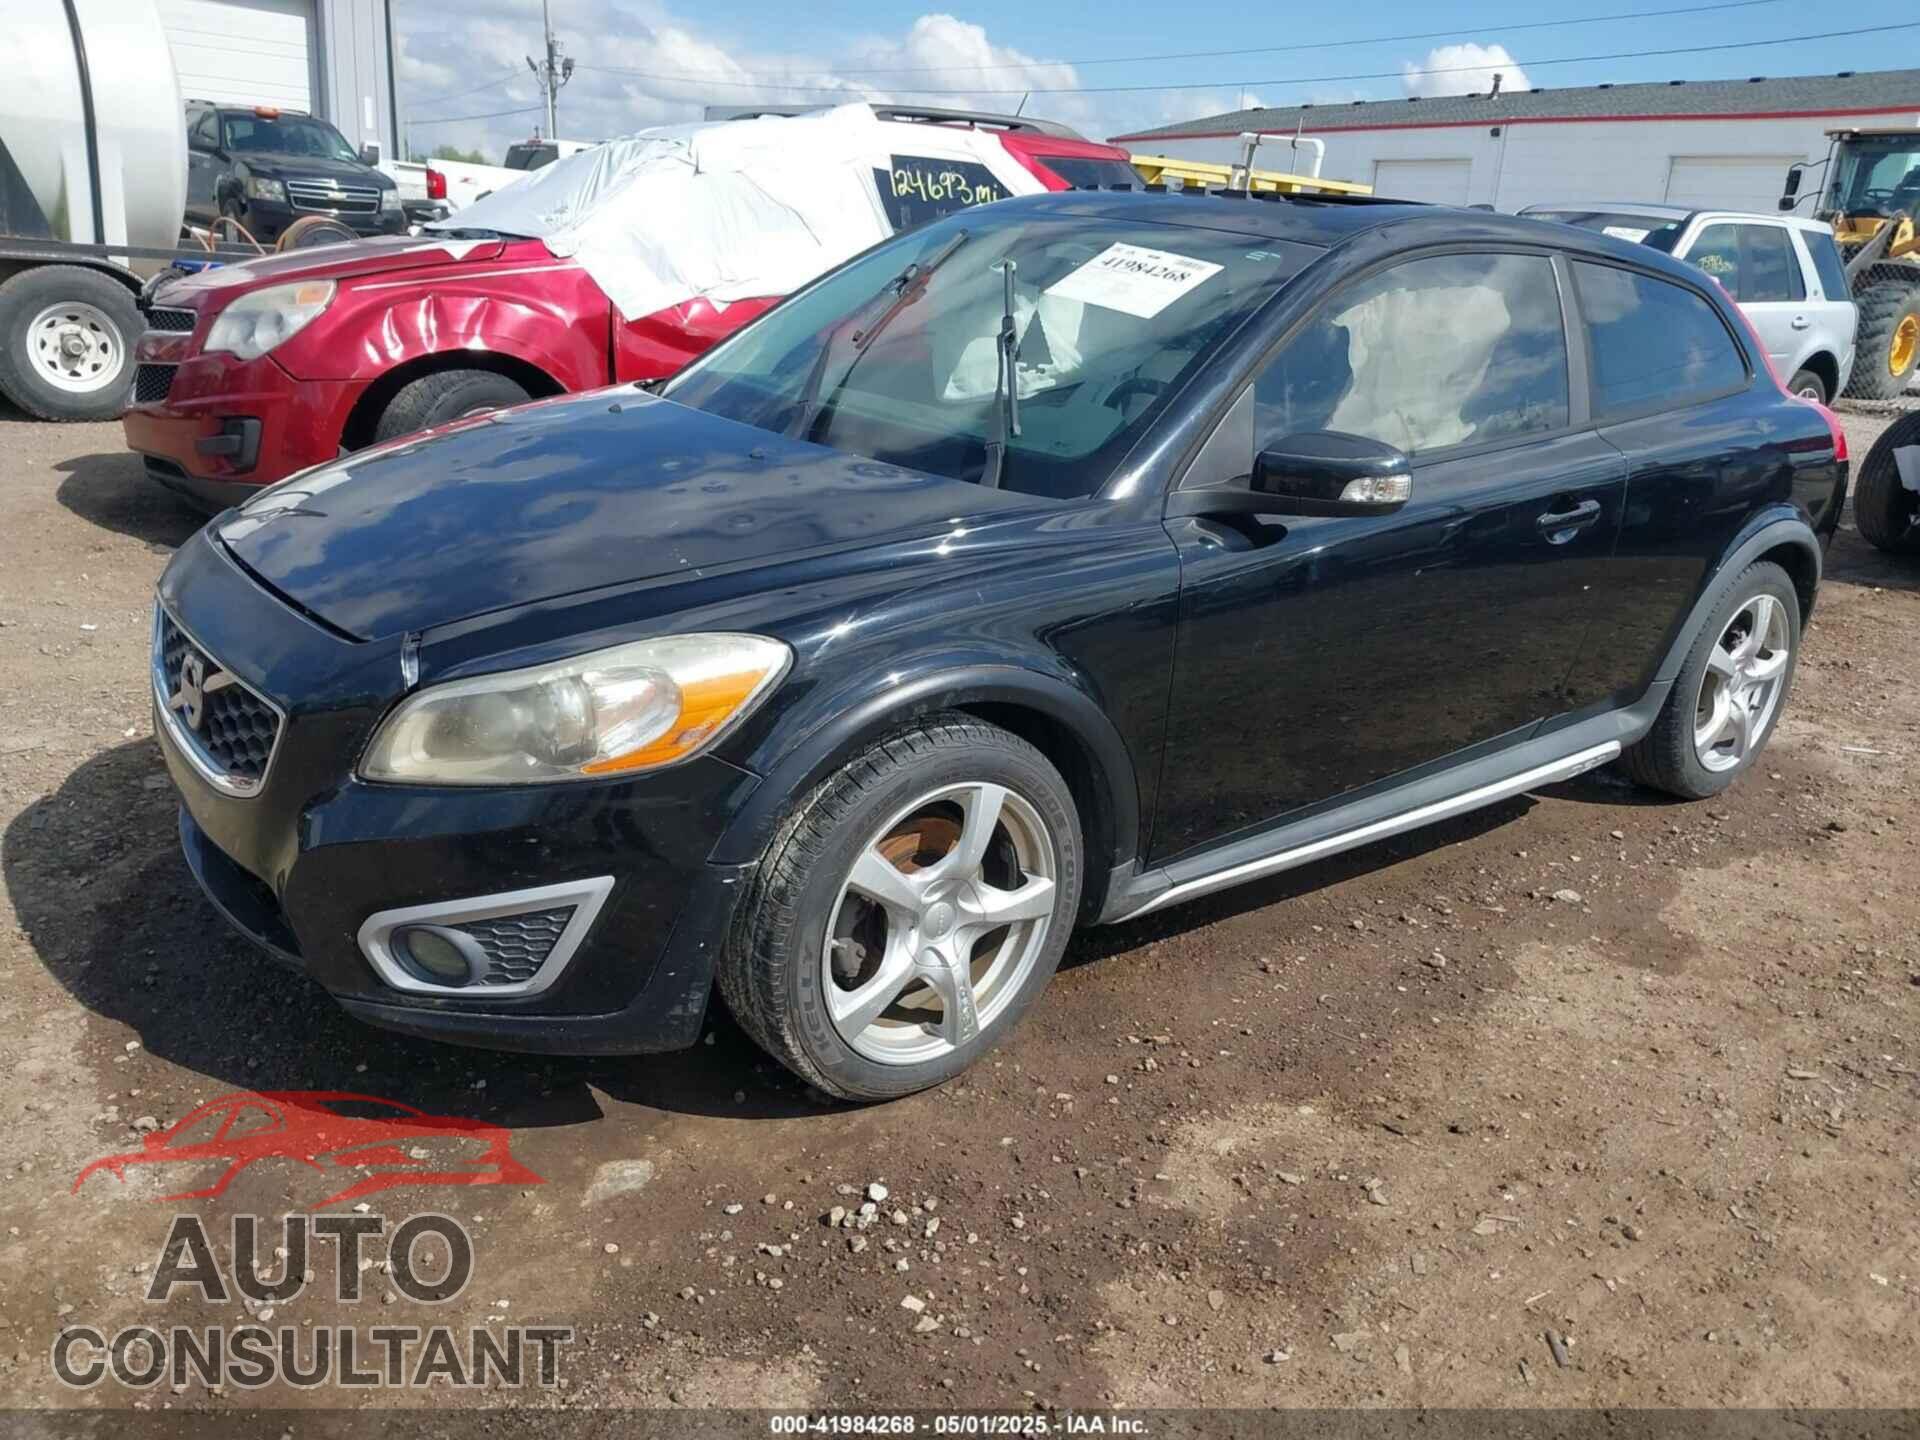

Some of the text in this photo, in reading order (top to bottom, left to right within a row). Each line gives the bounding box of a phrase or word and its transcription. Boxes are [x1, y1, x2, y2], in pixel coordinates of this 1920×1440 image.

[889, 168, 974, 204] 124693
[1102, 257, 1192, 281] 41984268
[798, 944, 832, 1052] KELLY
